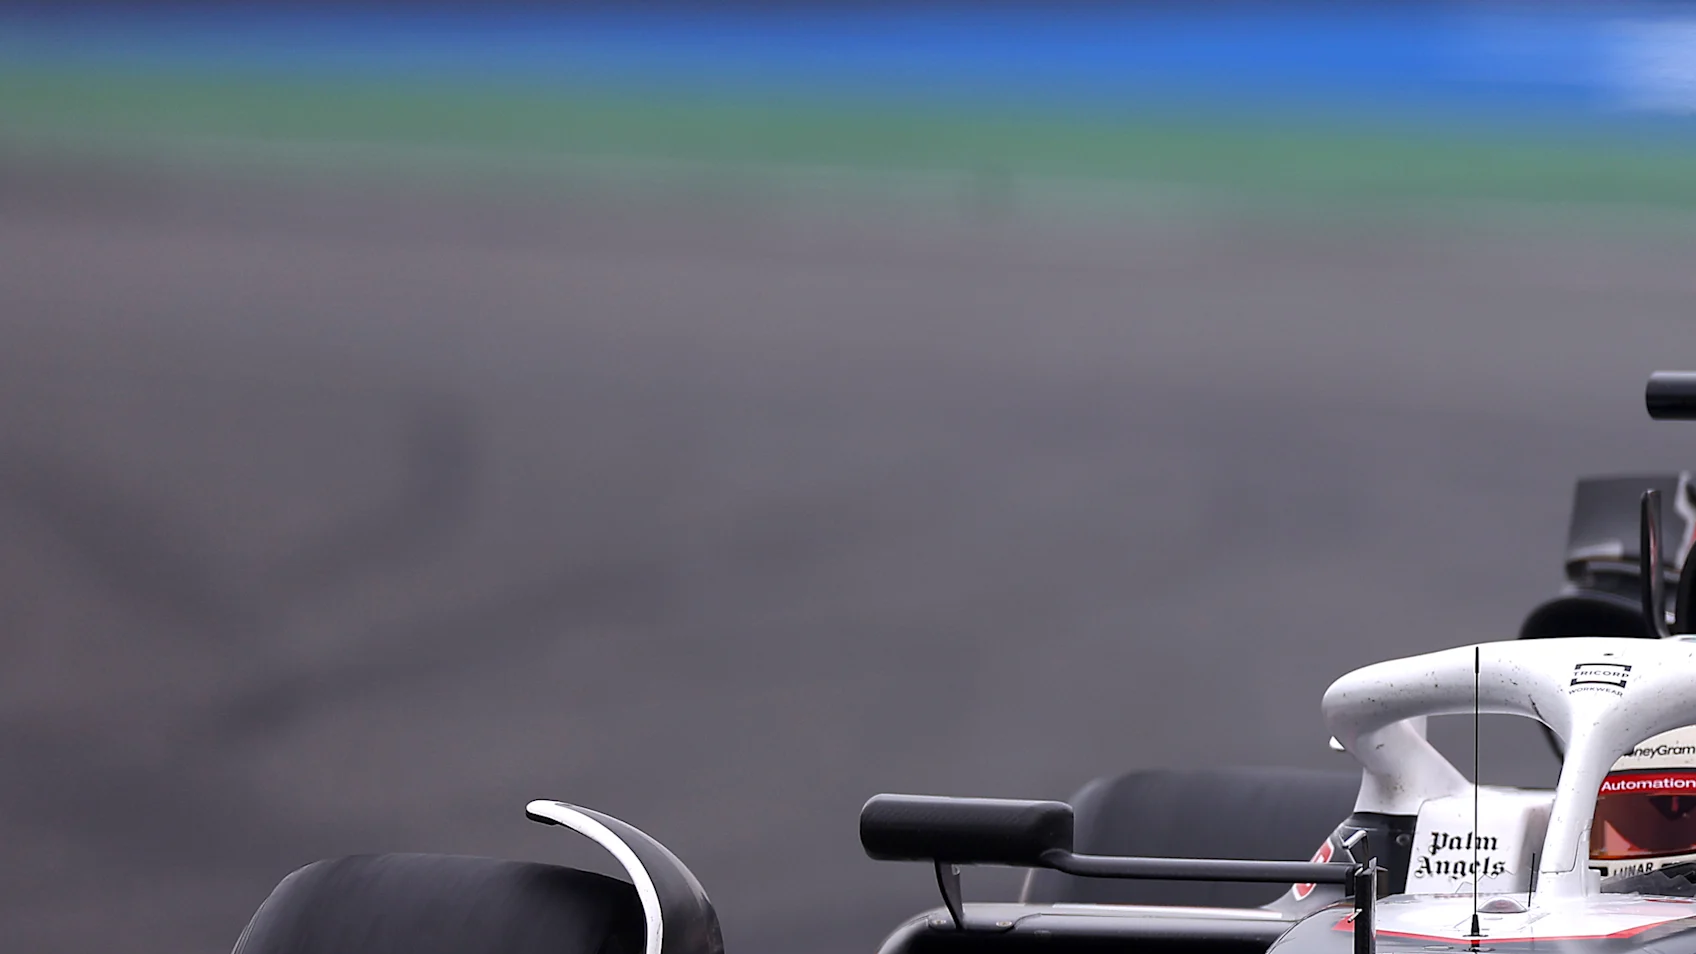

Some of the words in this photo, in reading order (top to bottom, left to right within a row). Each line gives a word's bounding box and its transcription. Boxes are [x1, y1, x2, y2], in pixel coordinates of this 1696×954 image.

[1624, 744, 1696, 759] neyGram
[1428, 831, 1499, 856] Palm
[1414, 855, 1506, 880] Angels
